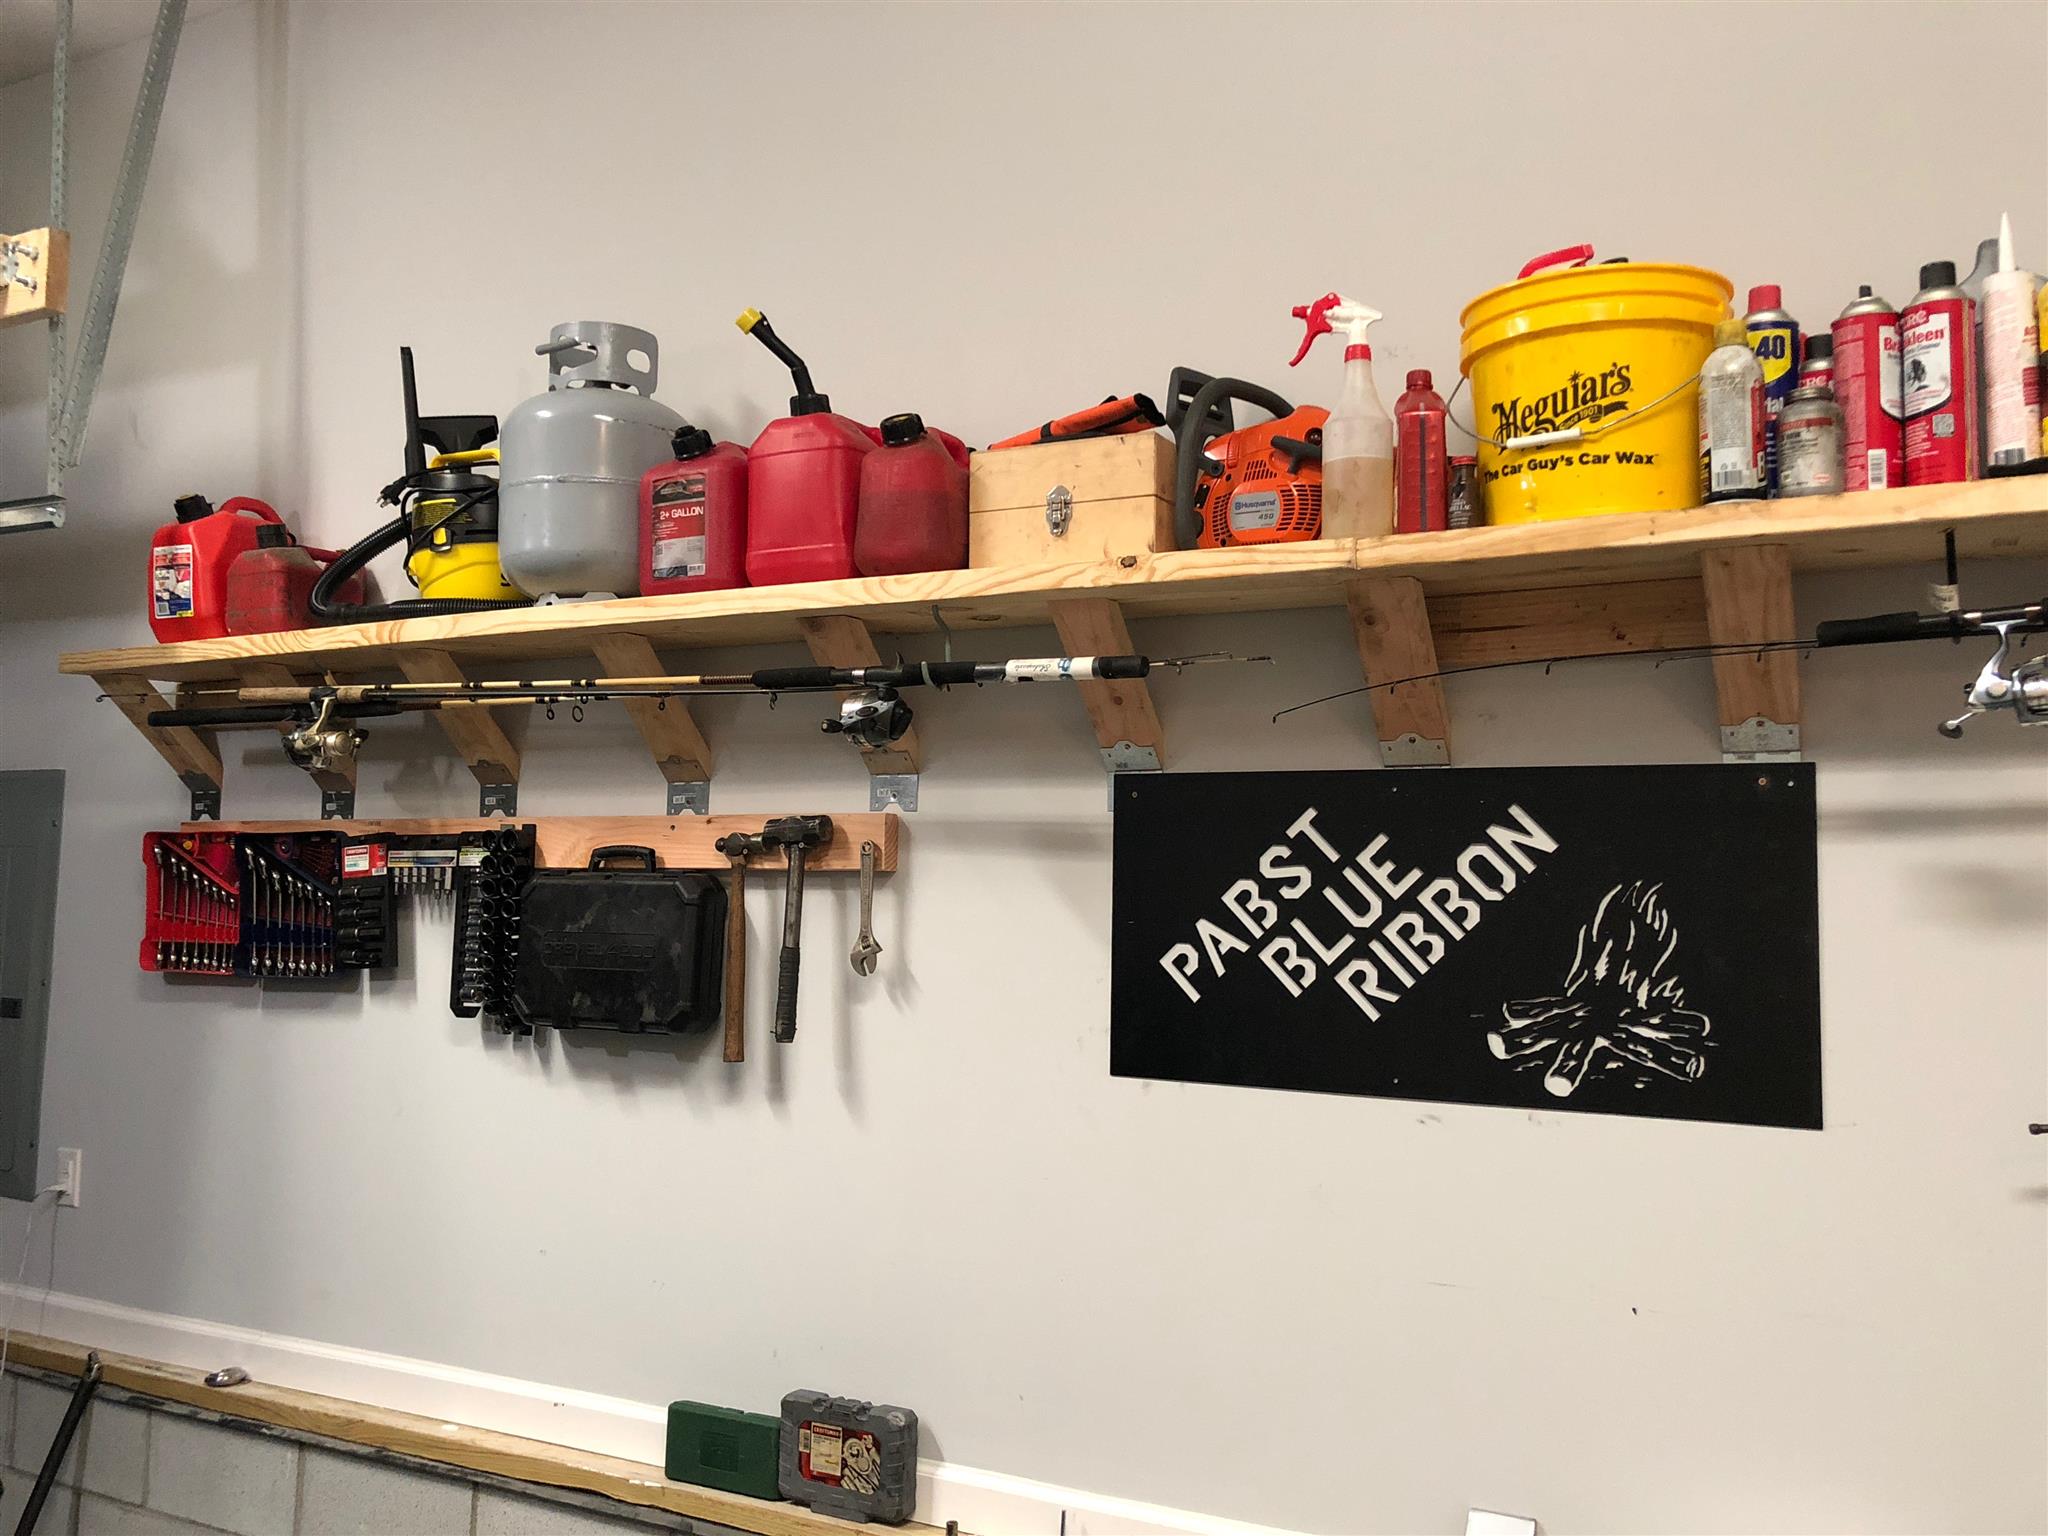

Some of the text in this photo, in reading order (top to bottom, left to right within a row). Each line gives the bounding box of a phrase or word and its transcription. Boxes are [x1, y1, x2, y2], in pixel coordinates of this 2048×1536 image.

[1491, 362, 1632, 455] Meguiar's
[1579, 405, 1599, 419] 1901
[1484, 468, 1499, 484] The
[1501, 462, 1524, 478] Car
[1527, 455, 1575, 471] Guy's
[1578, 452, 1611, 465] Car
[659, 506, 704, 520] 2+ GALLON
[1241, 499, 1276, 509] Husqvarna
[1159, 806, 1342, 1004] PABST
[1257, 832, 1424, 998] BLUE
[1333, 803, 1560, 1023] RIBBON
